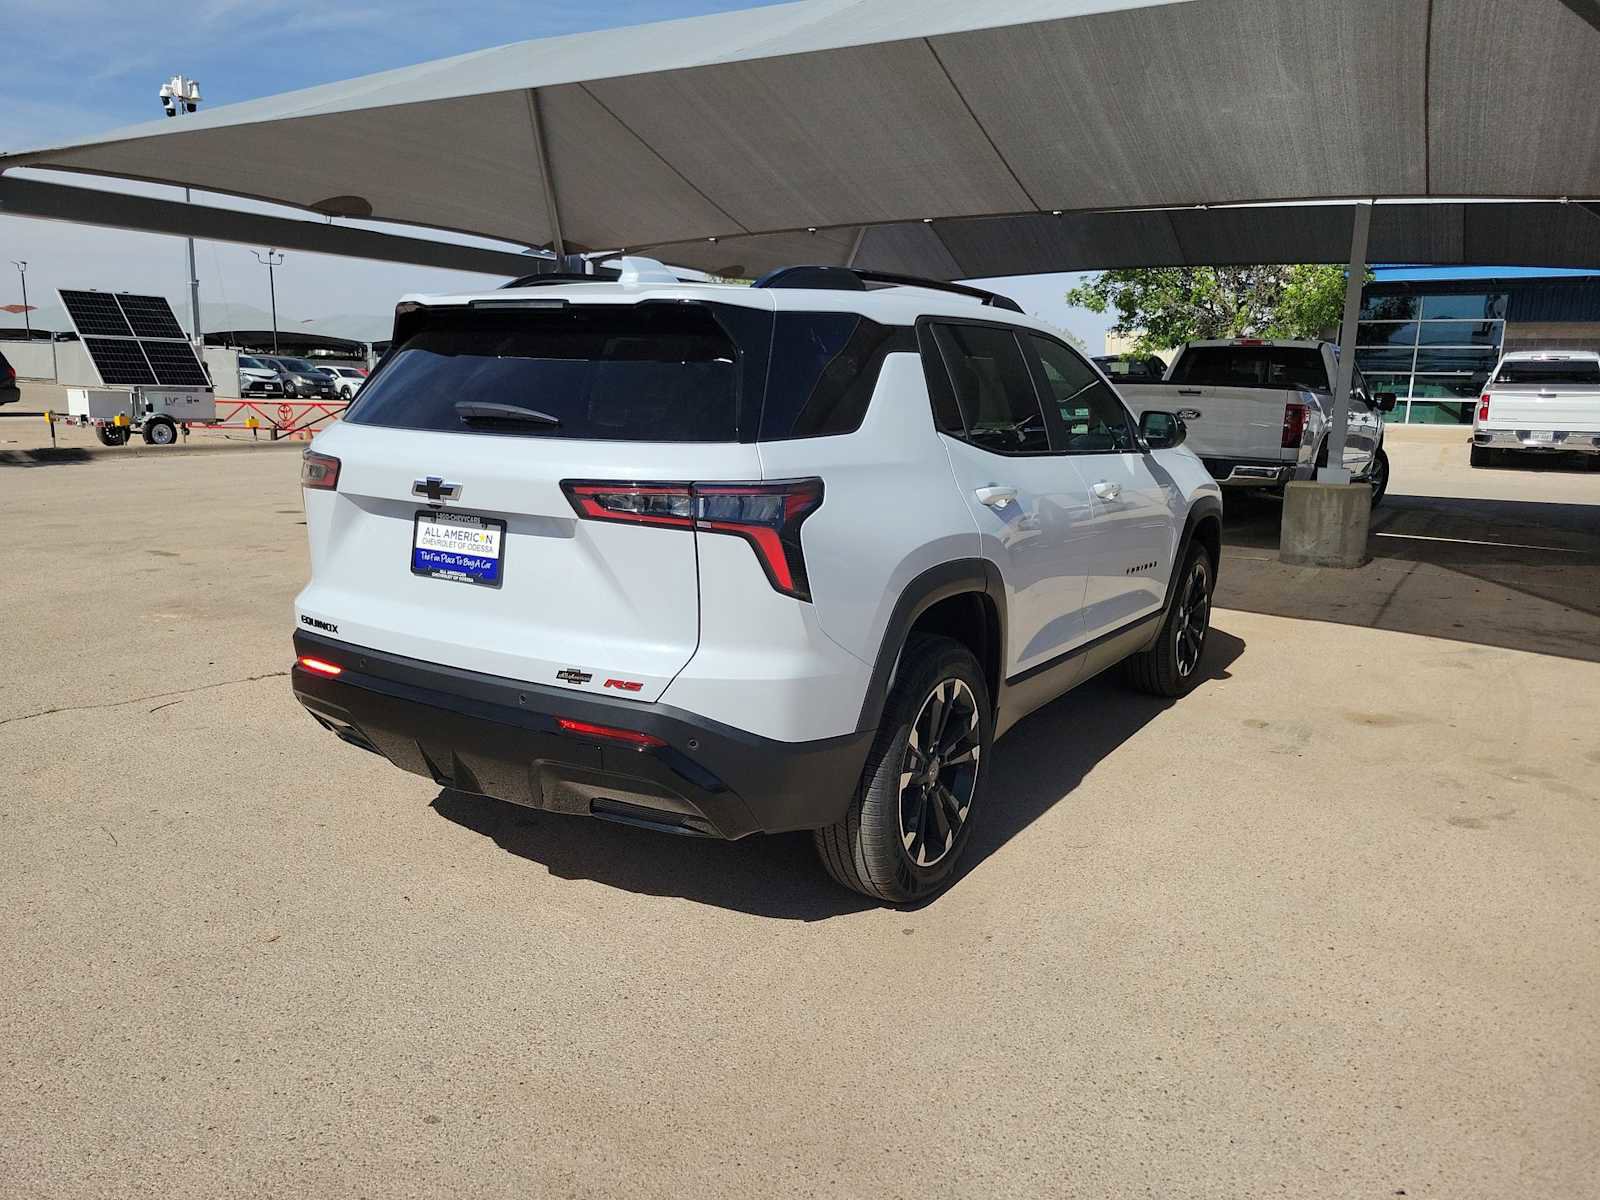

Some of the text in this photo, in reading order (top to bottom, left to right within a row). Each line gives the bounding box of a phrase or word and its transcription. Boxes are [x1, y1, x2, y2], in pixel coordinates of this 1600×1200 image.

[424, 527, 441, 538] ALL
[422, 538, 493, 553] CHEVROLET OF ODESSA
[421, 551, 492, 570] The Fun Place To Buy A Car
[301, 614, 339, 634] EQUINOX
[604, 679, 643, 692] RS
